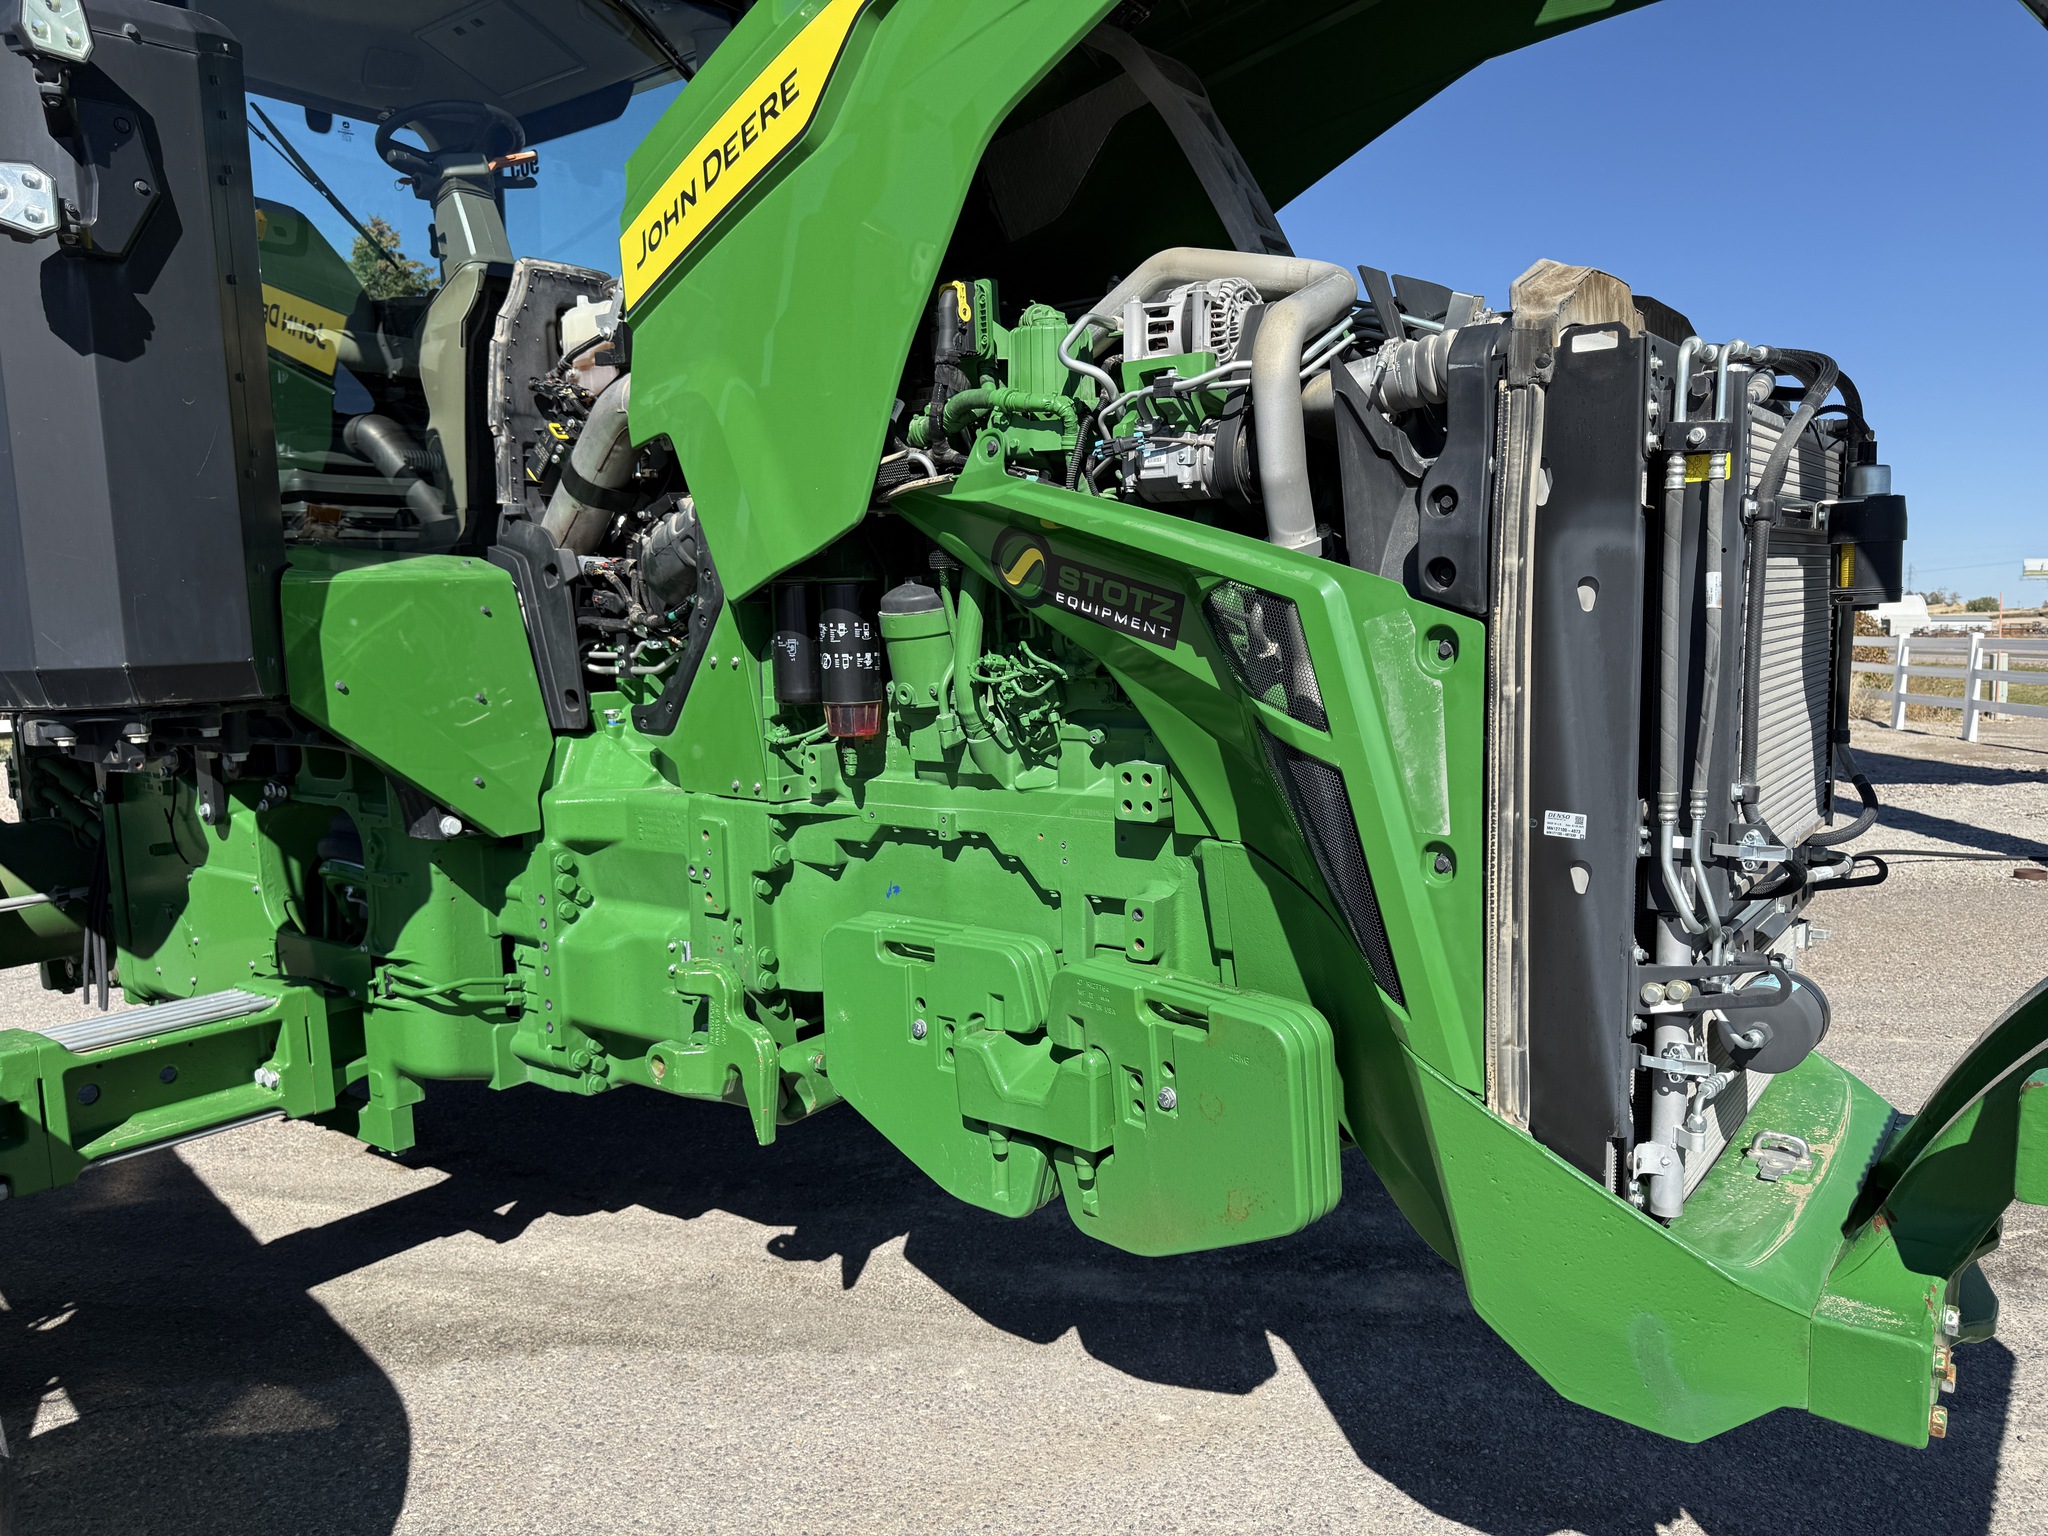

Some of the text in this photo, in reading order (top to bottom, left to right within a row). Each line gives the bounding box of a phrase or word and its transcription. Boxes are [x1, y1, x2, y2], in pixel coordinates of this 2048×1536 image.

[636, 66, 800, 271] JOHN DEERE
[1055, 591, 1171, 639] EQUIPMENT
[1058, 565, 1175, 623] STOTZ
[1548, 812, 1571, 820] DENSO
